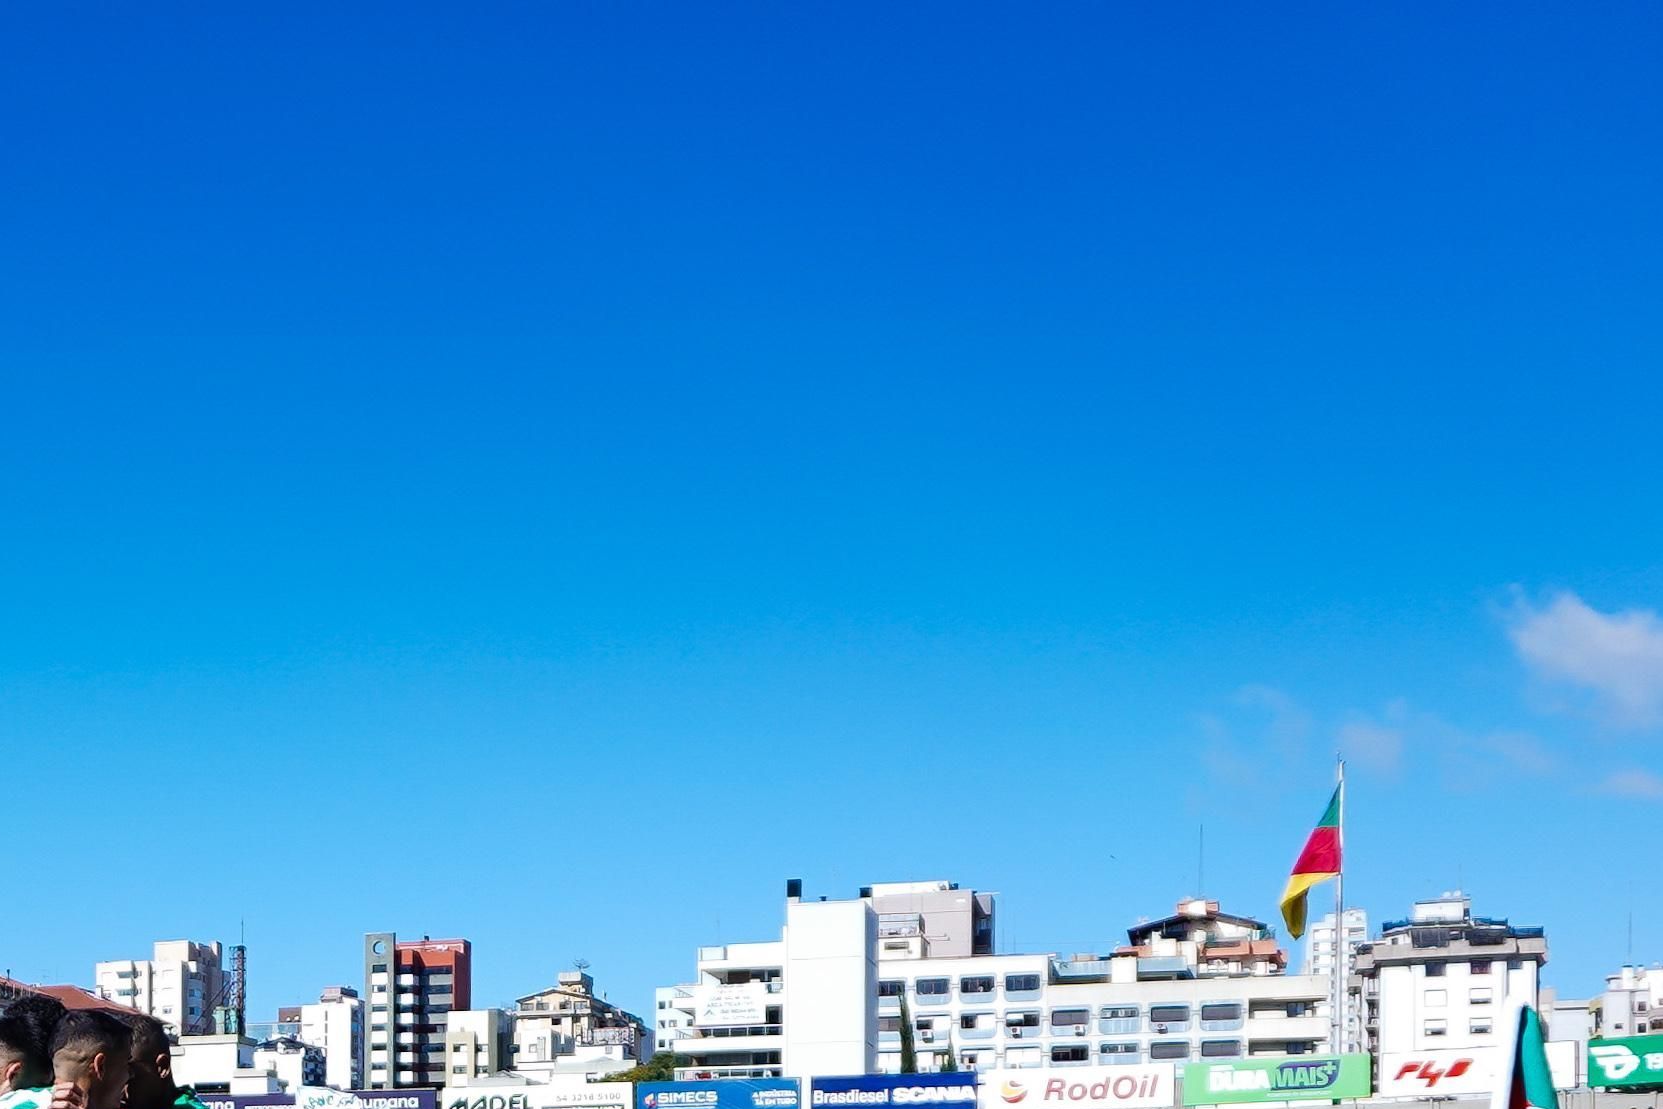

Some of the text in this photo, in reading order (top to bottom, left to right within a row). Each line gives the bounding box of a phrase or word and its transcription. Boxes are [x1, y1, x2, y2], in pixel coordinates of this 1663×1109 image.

[813, 1086, 977, 1104] Brasdiesel SCANIA
[1043, 1073, 1159, 1102] RodOil
[657, 1091, 718, 1104] SIMECS
